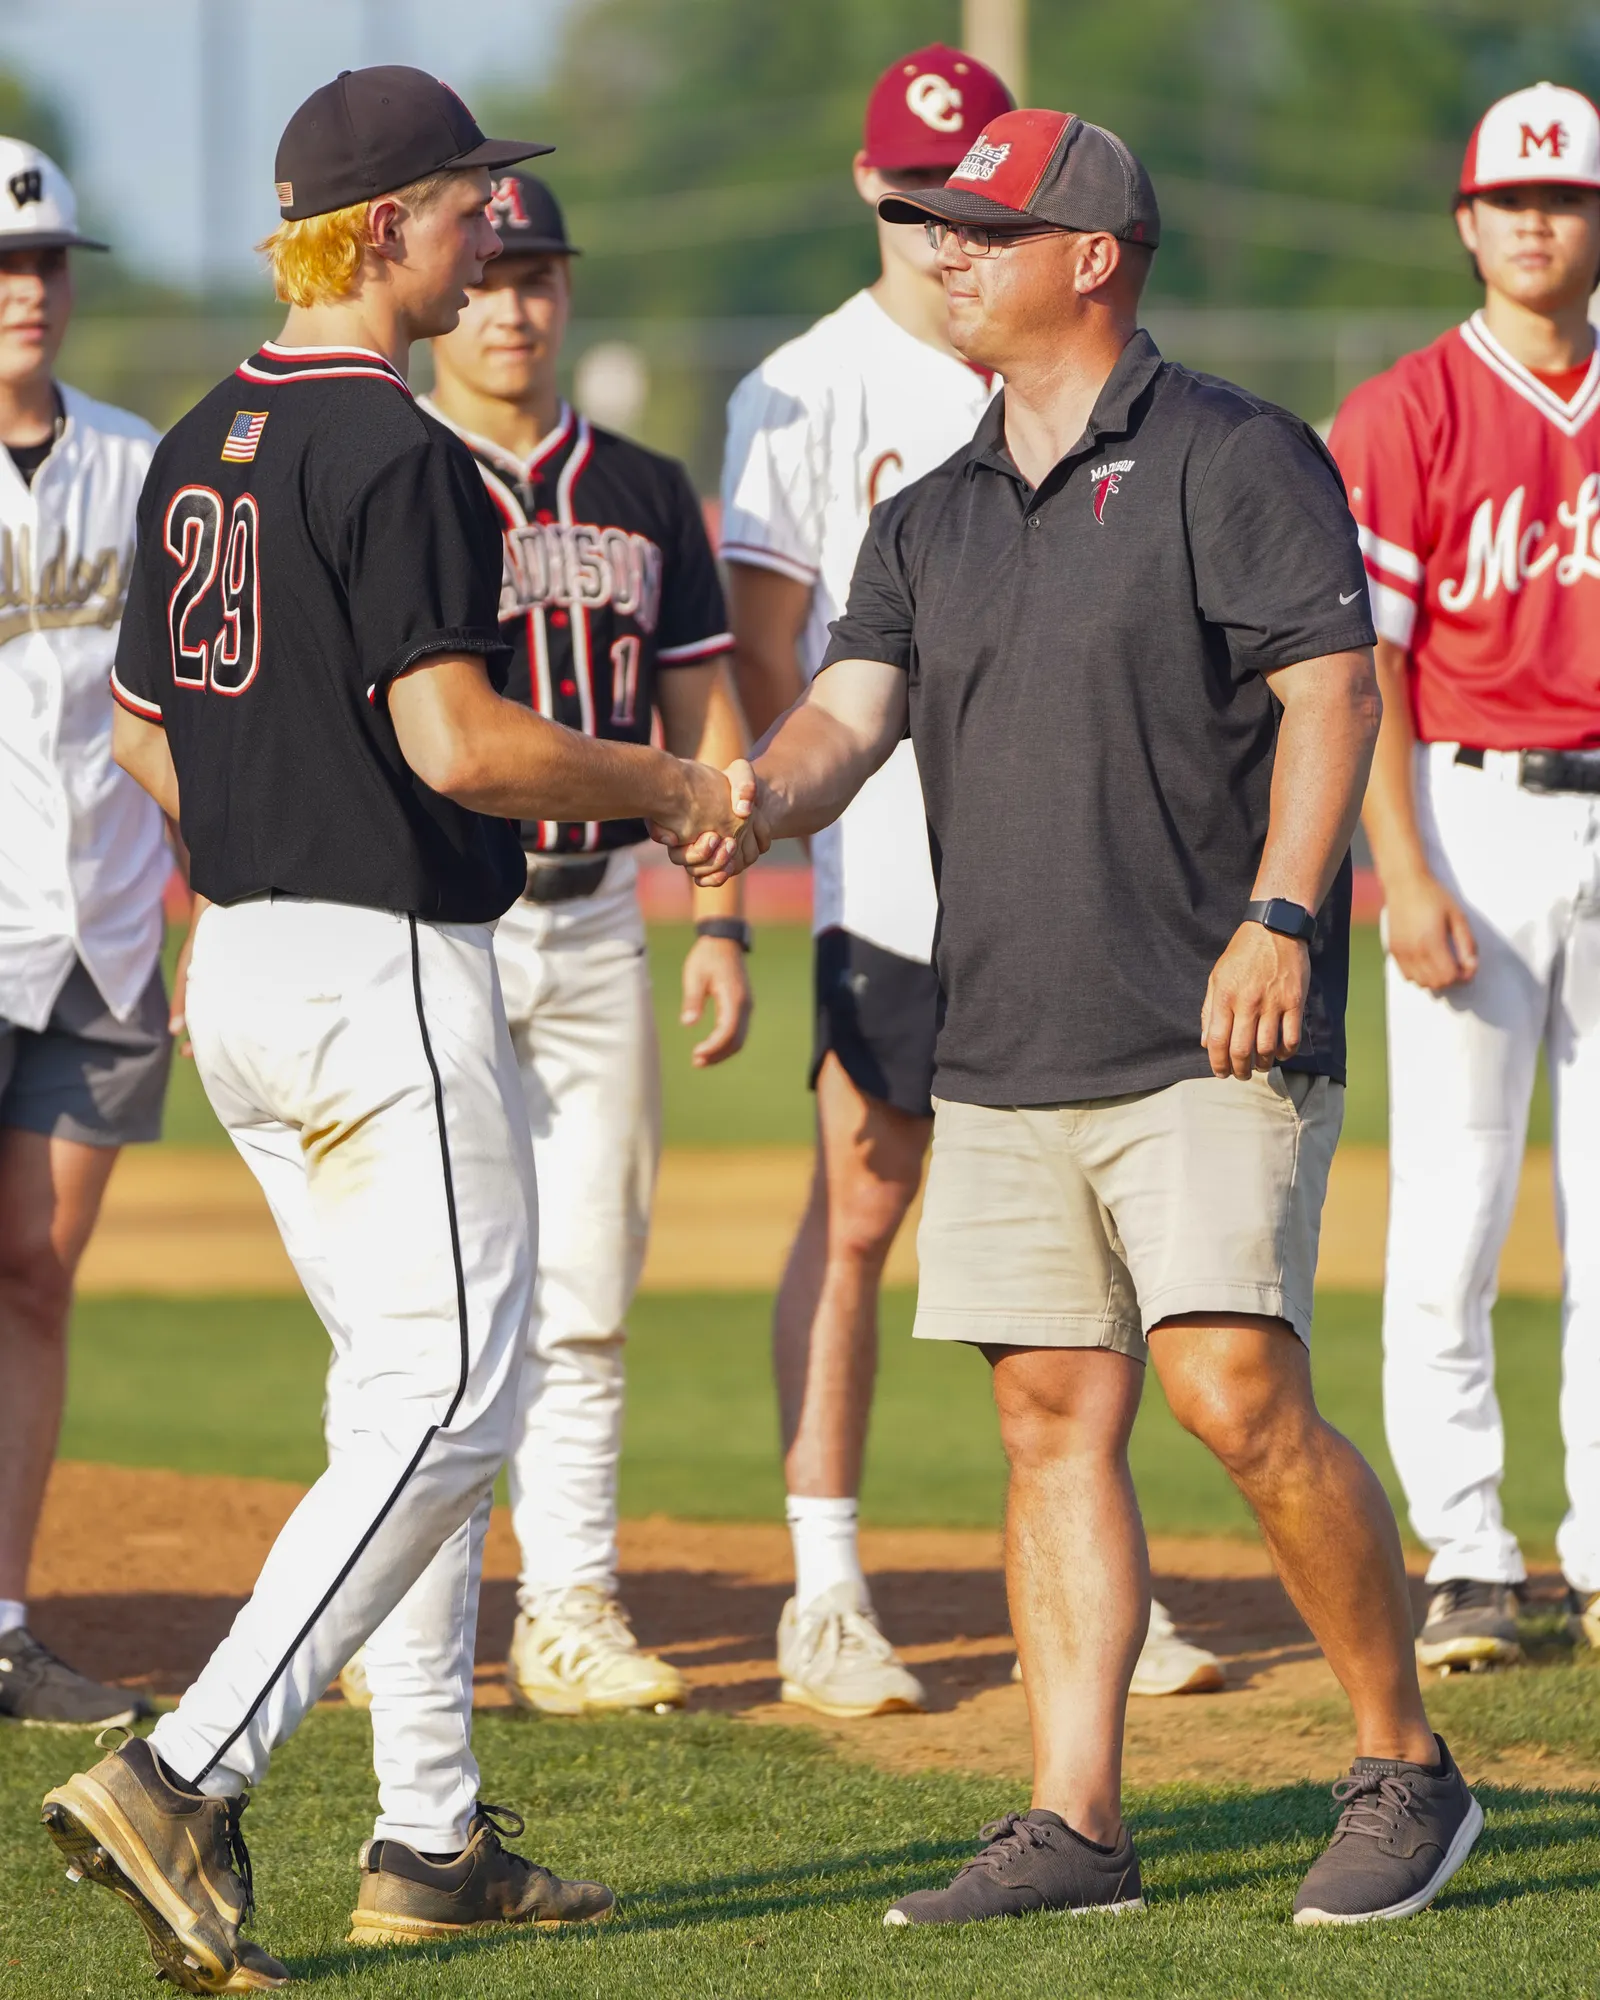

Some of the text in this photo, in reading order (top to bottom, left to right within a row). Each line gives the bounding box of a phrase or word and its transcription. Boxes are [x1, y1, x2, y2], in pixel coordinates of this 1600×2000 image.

[485, 176, 532, 230] M
[1091, 460, 1136, 482] MADISON
[164, 484, 261, 697] 29
[498, 523, 663, 635] ADISON
[1438, 472, 1600, 612] McL
[610, 635, 641, 726] 1
